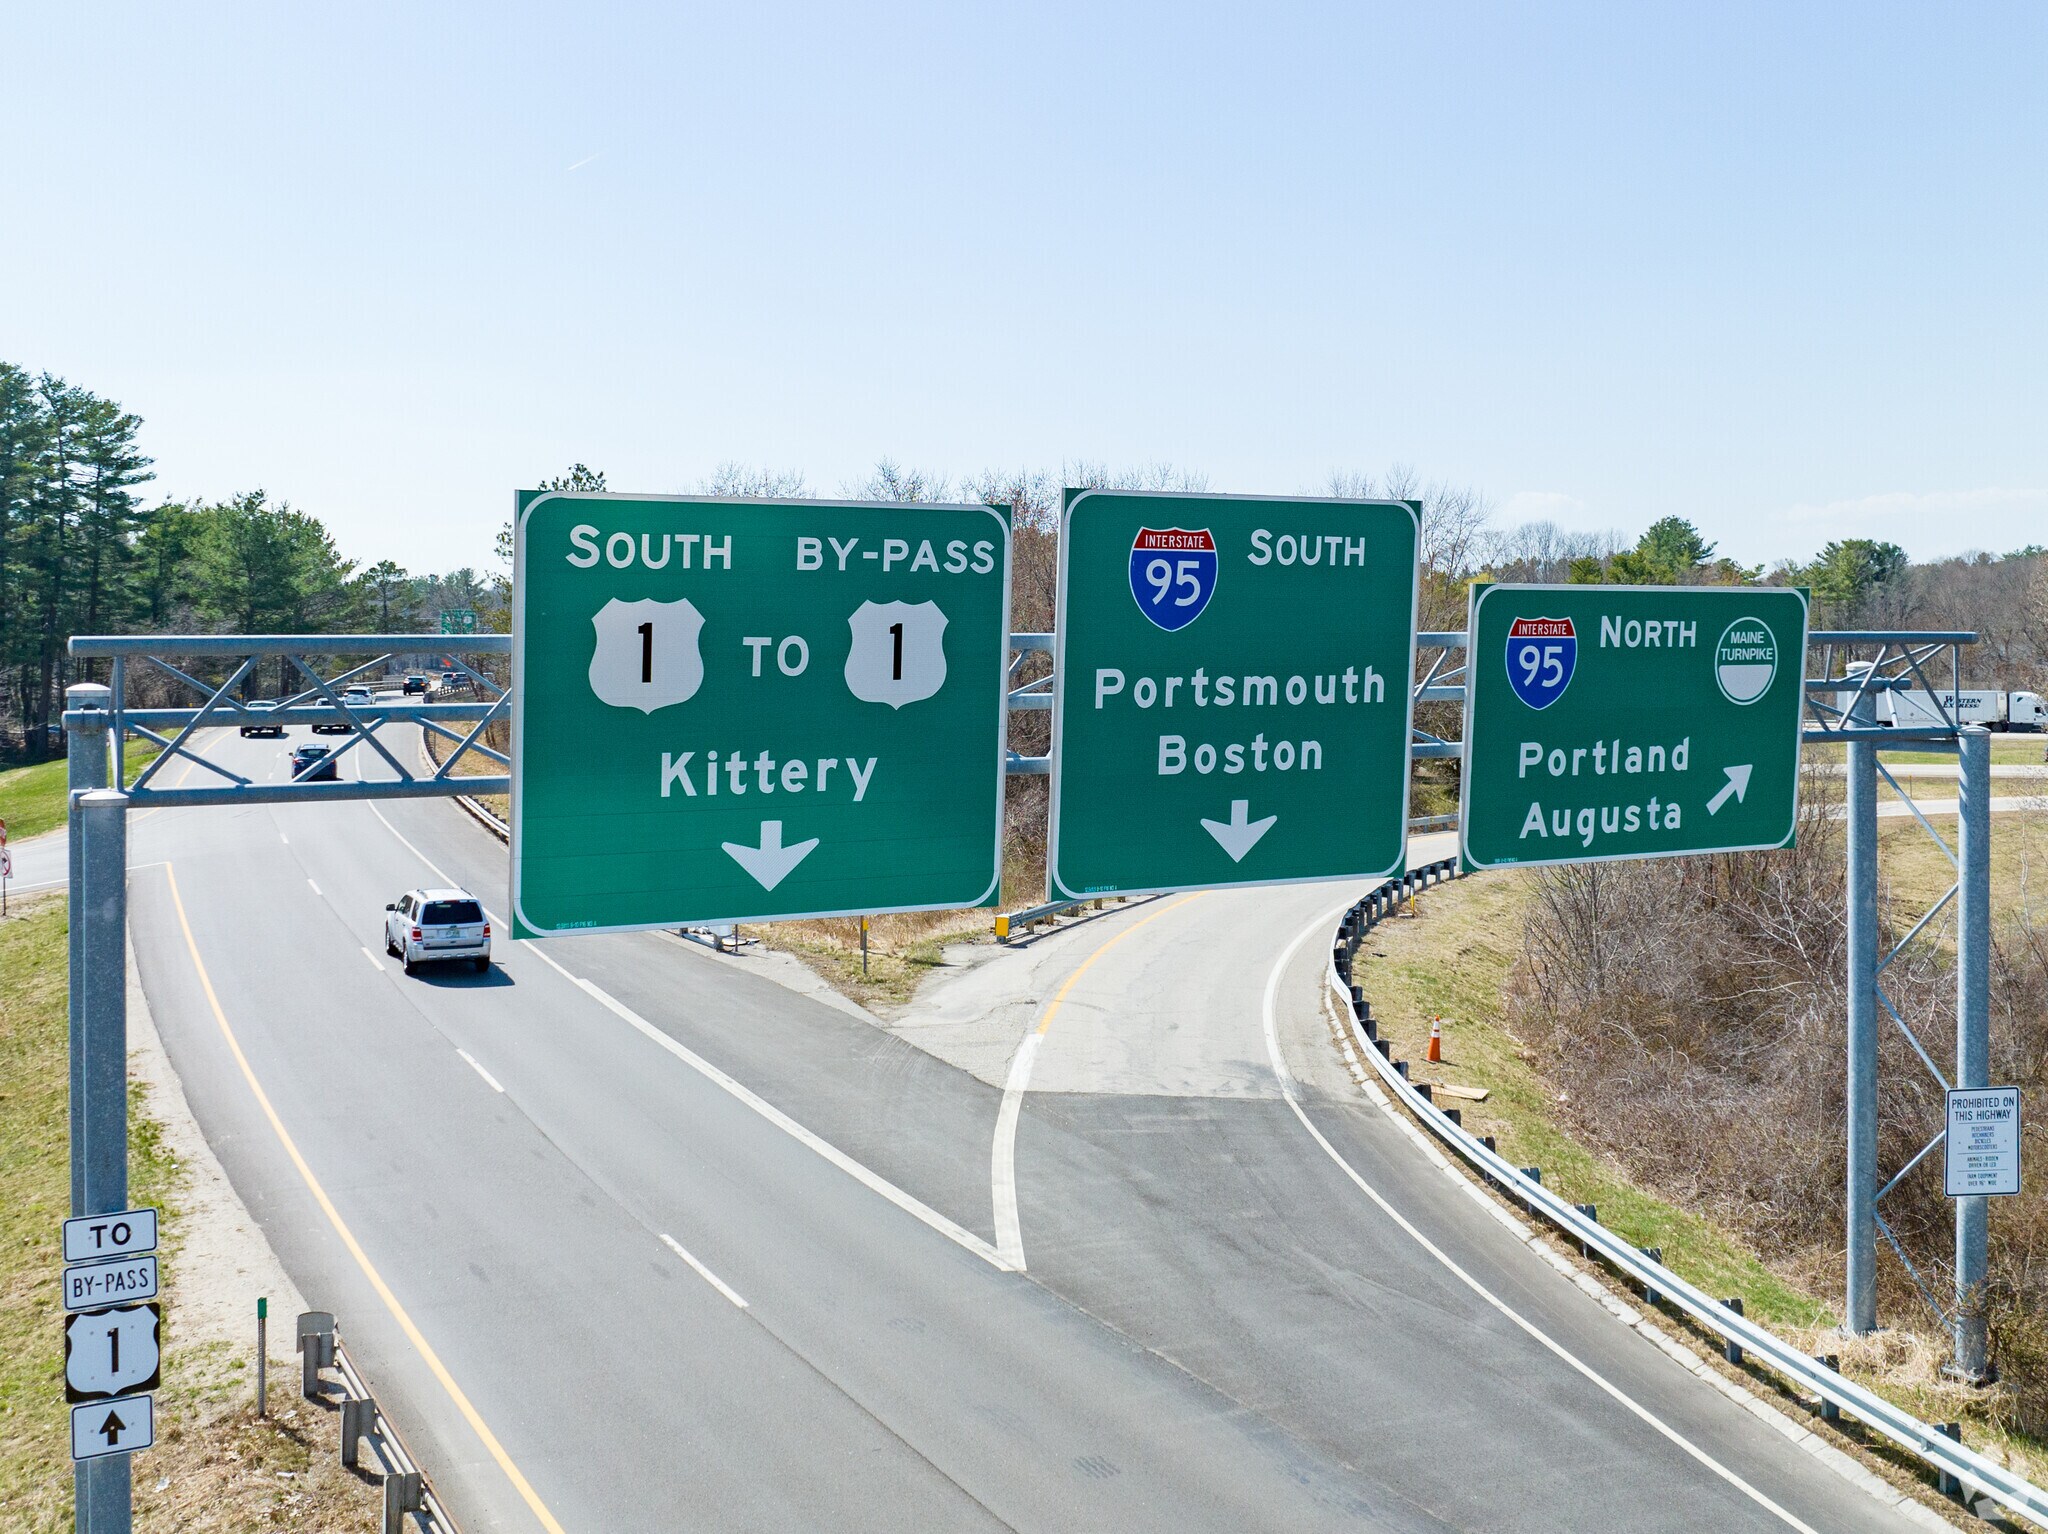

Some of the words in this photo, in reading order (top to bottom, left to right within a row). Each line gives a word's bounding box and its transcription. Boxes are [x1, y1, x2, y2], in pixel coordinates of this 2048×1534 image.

[566, 524, 732, 570] SOUTH
[797, 537, 995, 574] BY-PASS
[1144, 534, 1205, 549] INTERSTATE
[1247, 528, 1365, 567] SOUTH
[1145, 559, 1201, 607] 95
[1518, 623, 1567, 635] INTERSTATE
[1600, 615, 1697, 648] NORTH
[1730, 631, 1765, 644] MAINE
[638, 622, 653, 683] 1
[742, 635, 809, 677] TO
[889, 622, 903, 681] 1
[1519, 645, 1563, 687] 95
[1721, 647, 1773, 661] TURNPIKE
[1095, 665, 1385, 709] Portsmouth
[1945, 695, 1982, 704] WSTERN
[1158, 733, 1322, 775] Boston
[1519, 736, 1689, 778] Portland
[660, 750, 878, 802] Kittery
[1519, 796, 1681, 848] Augusta
[1951, 1097, 2000, 1109] PROHIBITED
[2003, 1097, 2015, 1107] ON
[1954, 1110, 1973, 1121] THIS
[1976, 1109, 2012, 1120] HIGHWAY
[90, 1222, 132, 1249] TO
[73, 1267, 149, 1298] BY-PASS
[107, 1327, 119, 1373] 1
